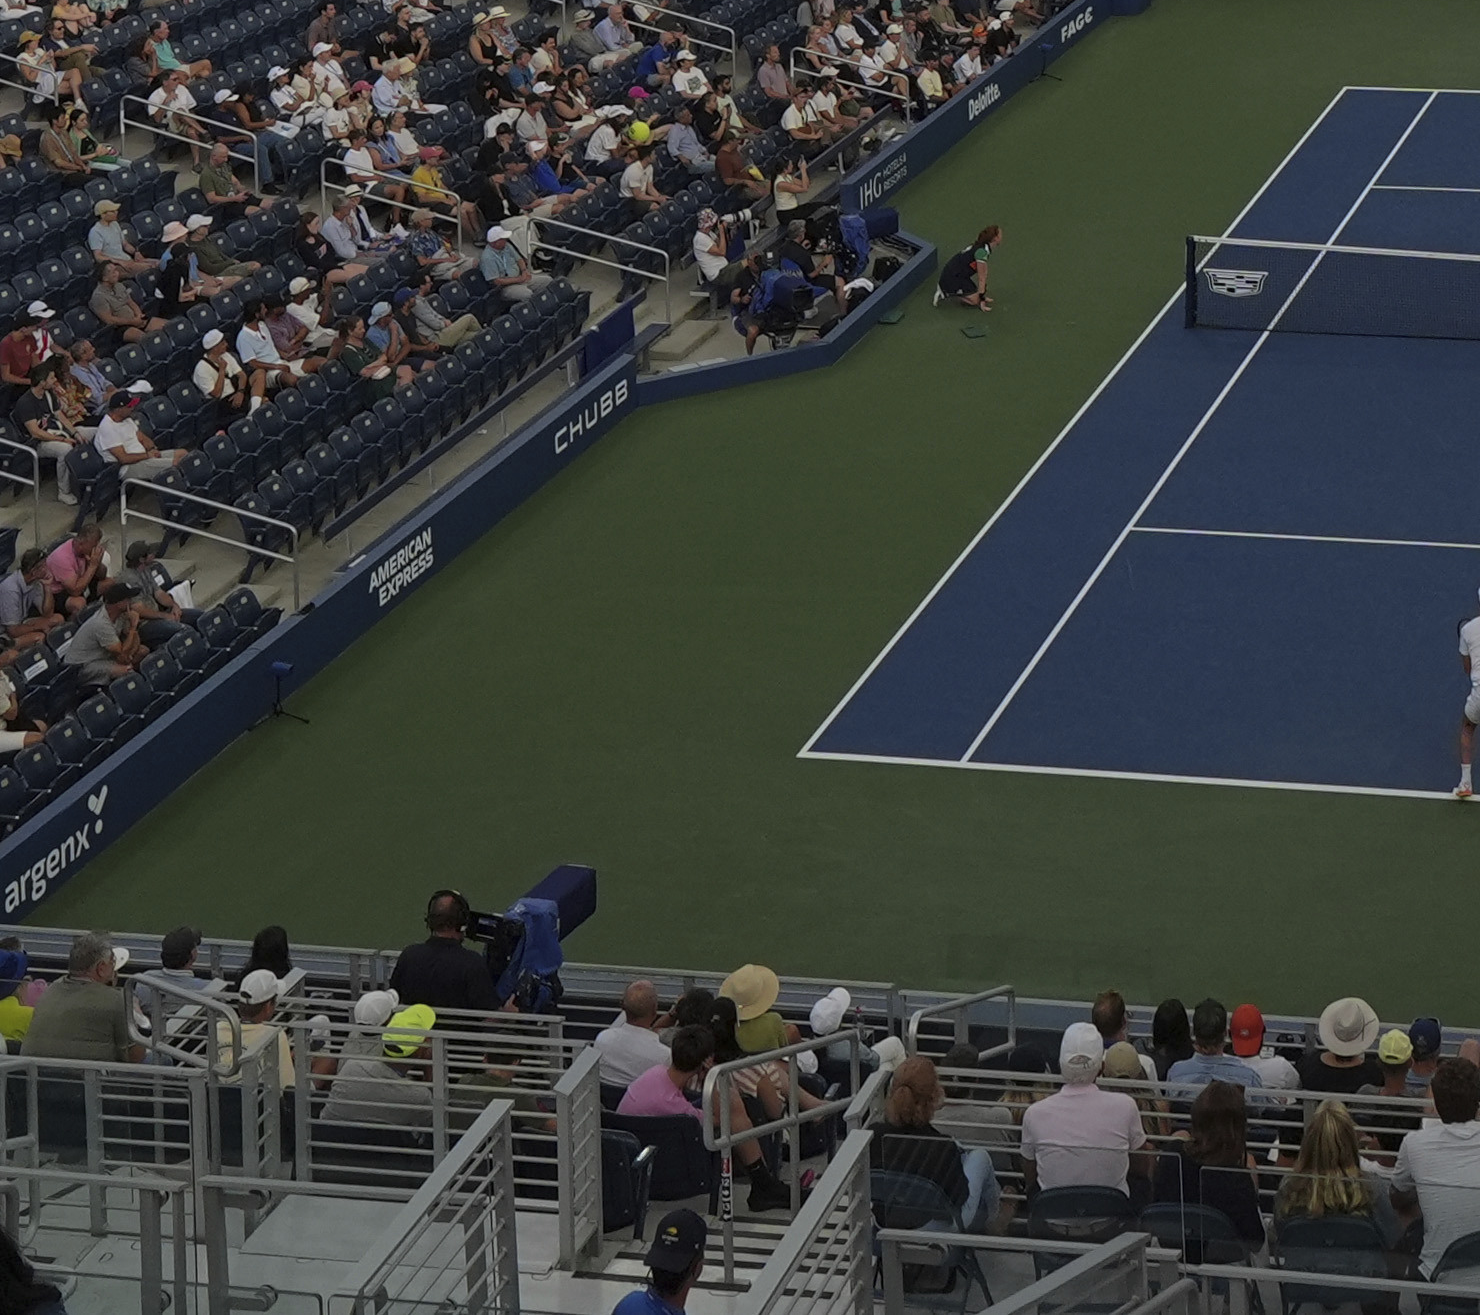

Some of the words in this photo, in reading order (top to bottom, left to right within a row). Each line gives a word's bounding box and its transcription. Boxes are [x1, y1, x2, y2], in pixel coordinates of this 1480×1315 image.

[968, 83, 1001, 121] Deloitte.
[859, 172, 883, 210] IHG
[883, 164, 907, 192] RESORTS
[554, 378, 628, 454] CHUBB
[369, 527, 432, 593] AMERICAN
[379, 547, 434, 607] EXPRESS
[5, 823, 90, 913] argenx
